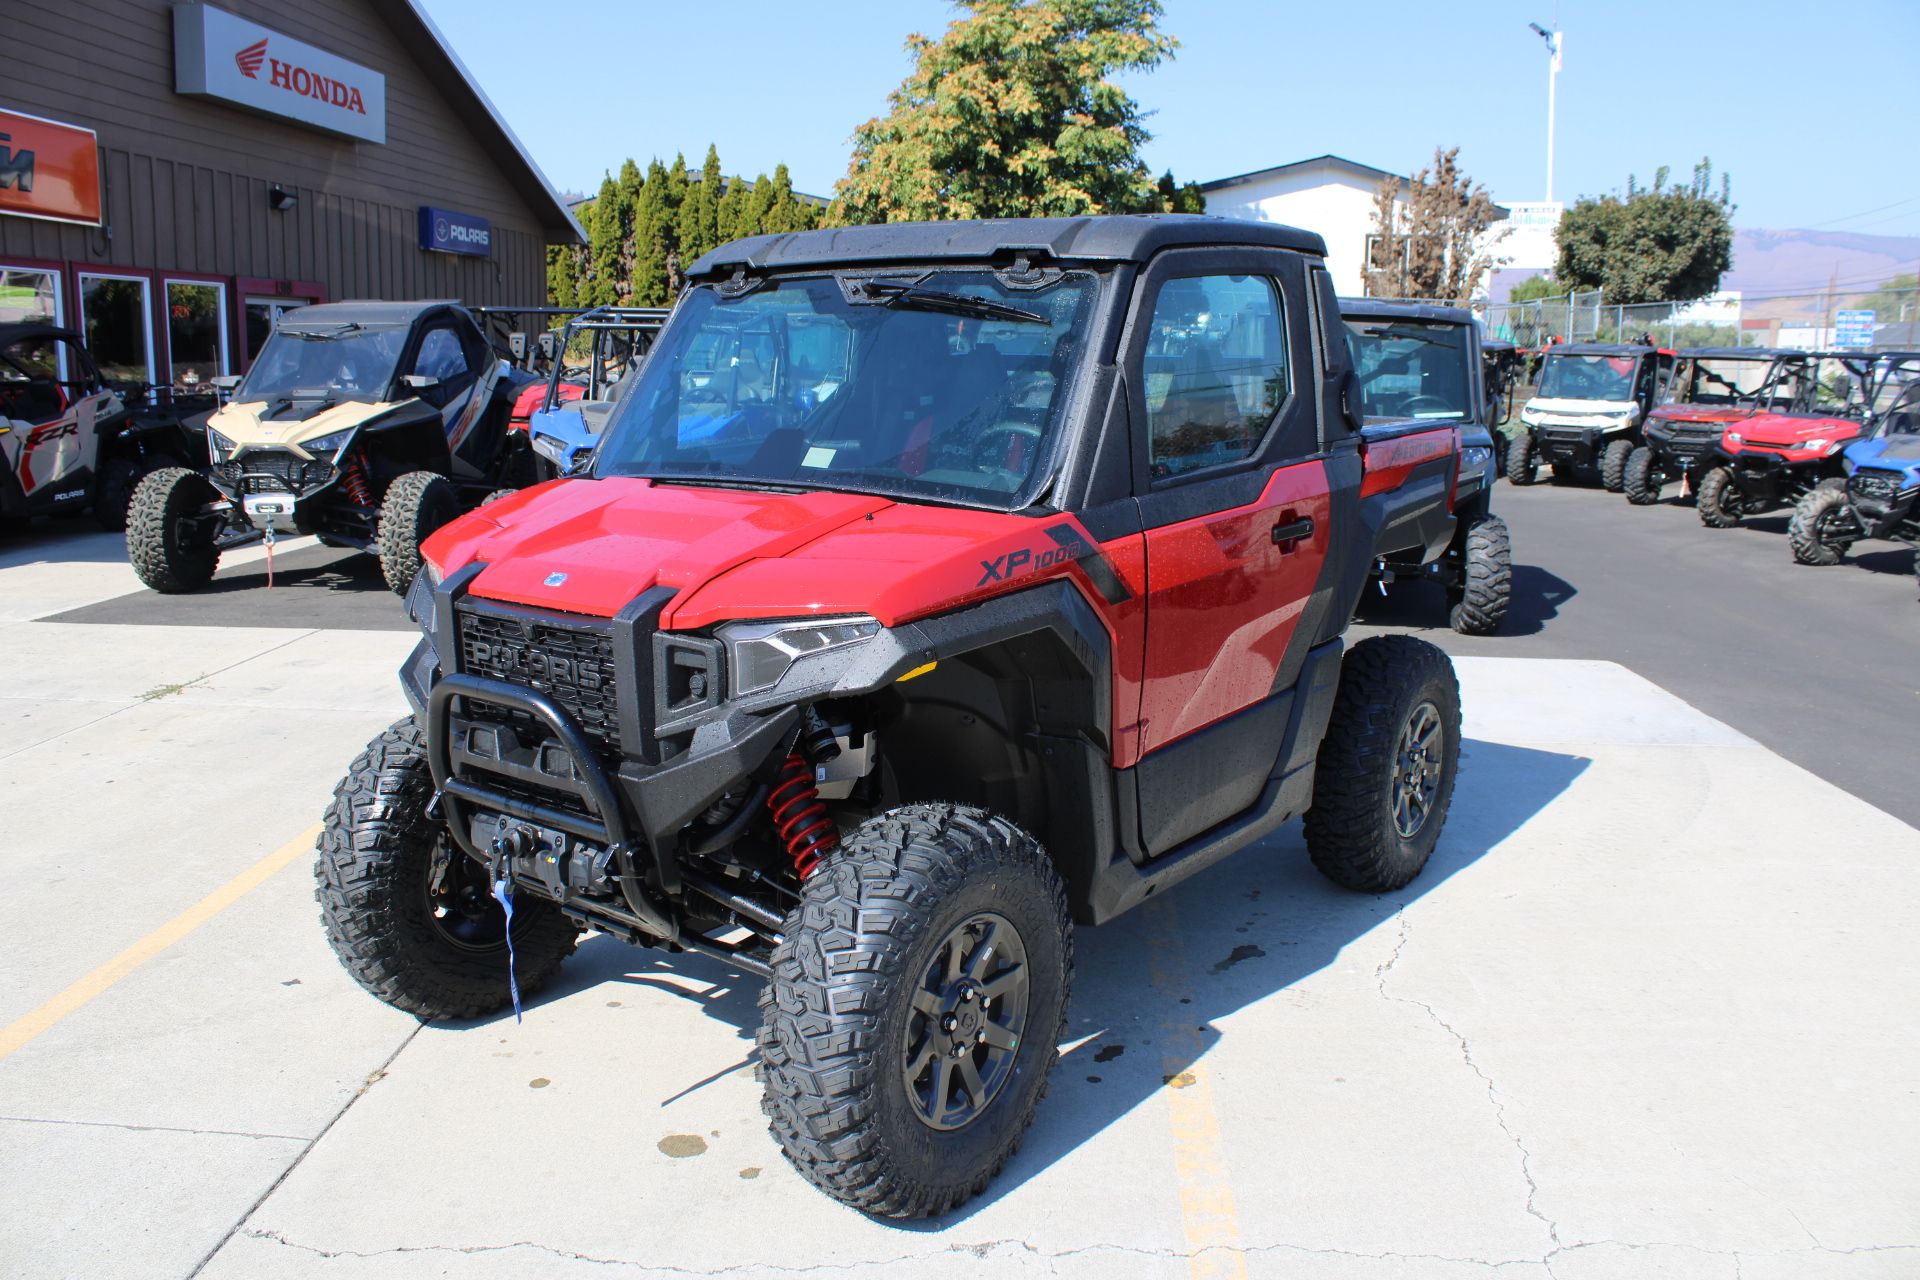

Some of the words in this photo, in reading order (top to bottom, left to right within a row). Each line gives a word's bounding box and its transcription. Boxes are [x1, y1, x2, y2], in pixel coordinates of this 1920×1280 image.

[269, 57, 366, 115] HONDA
[450, 223, 489, 246] POLARIS
[24, 422, 79, 449] RZR
[54, 488, 85, 501] POLARIS
[976, 548, 1031, 588] XP
[1033, 541, 1081, 571] 1000
[471, 640, 602, 690] POLARIS
